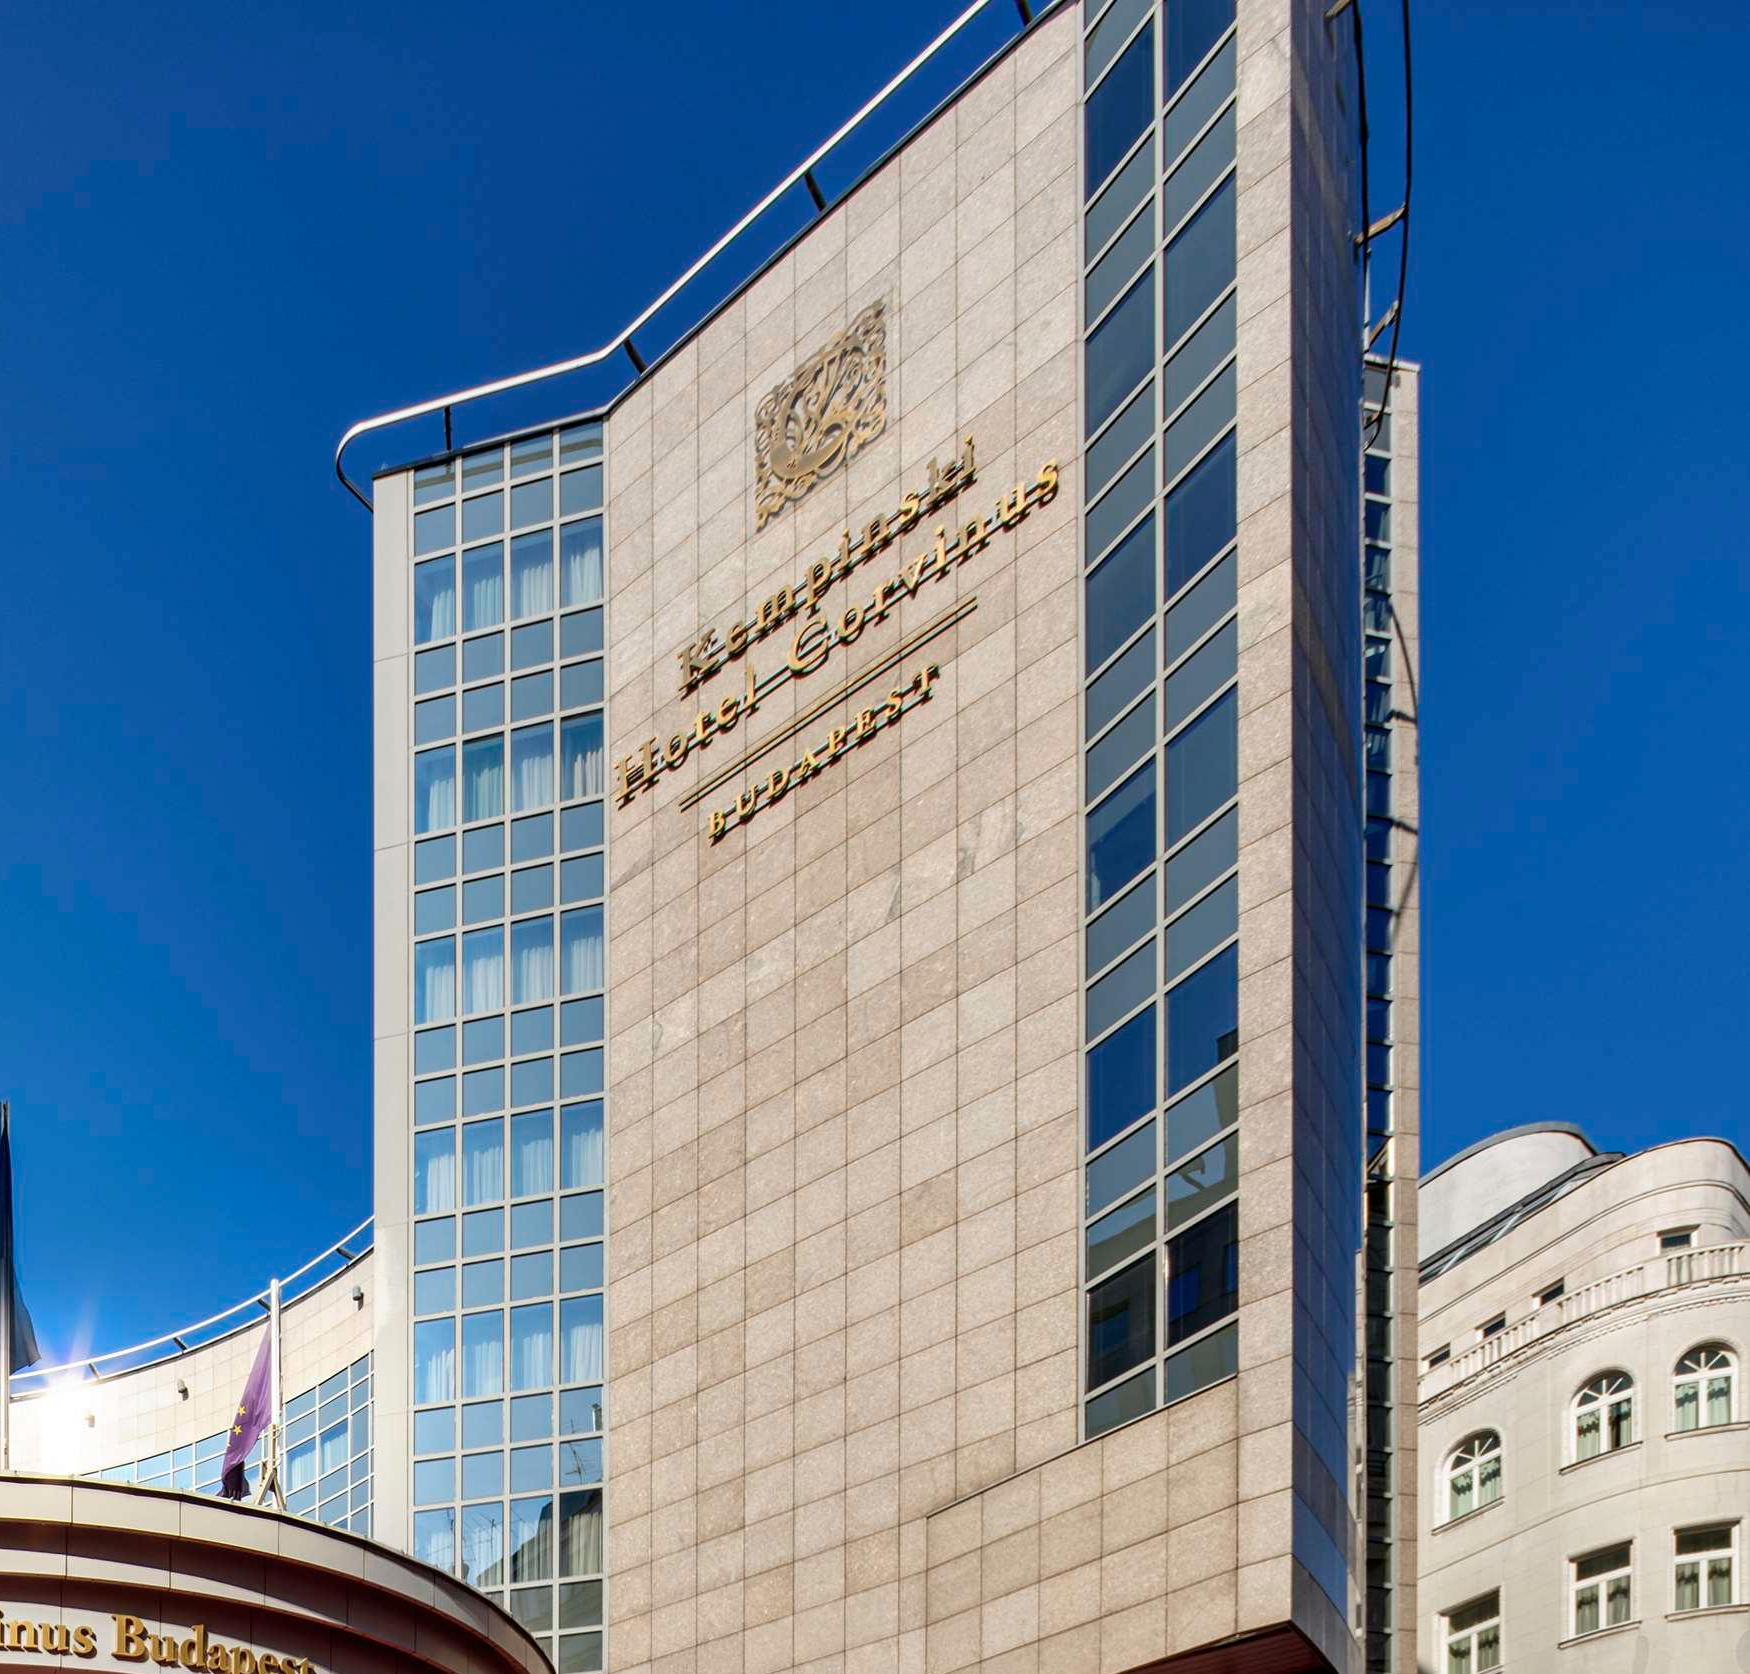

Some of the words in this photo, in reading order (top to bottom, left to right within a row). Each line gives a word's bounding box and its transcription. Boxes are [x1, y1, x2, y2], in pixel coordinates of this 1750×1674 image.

[613, 663, 759, 807] Hotel
[787, 458, 1060, 677] Corvinus
[677, 435, 978, 696] Kempinski
[707, 662, 939, 843] BUDAPEST
